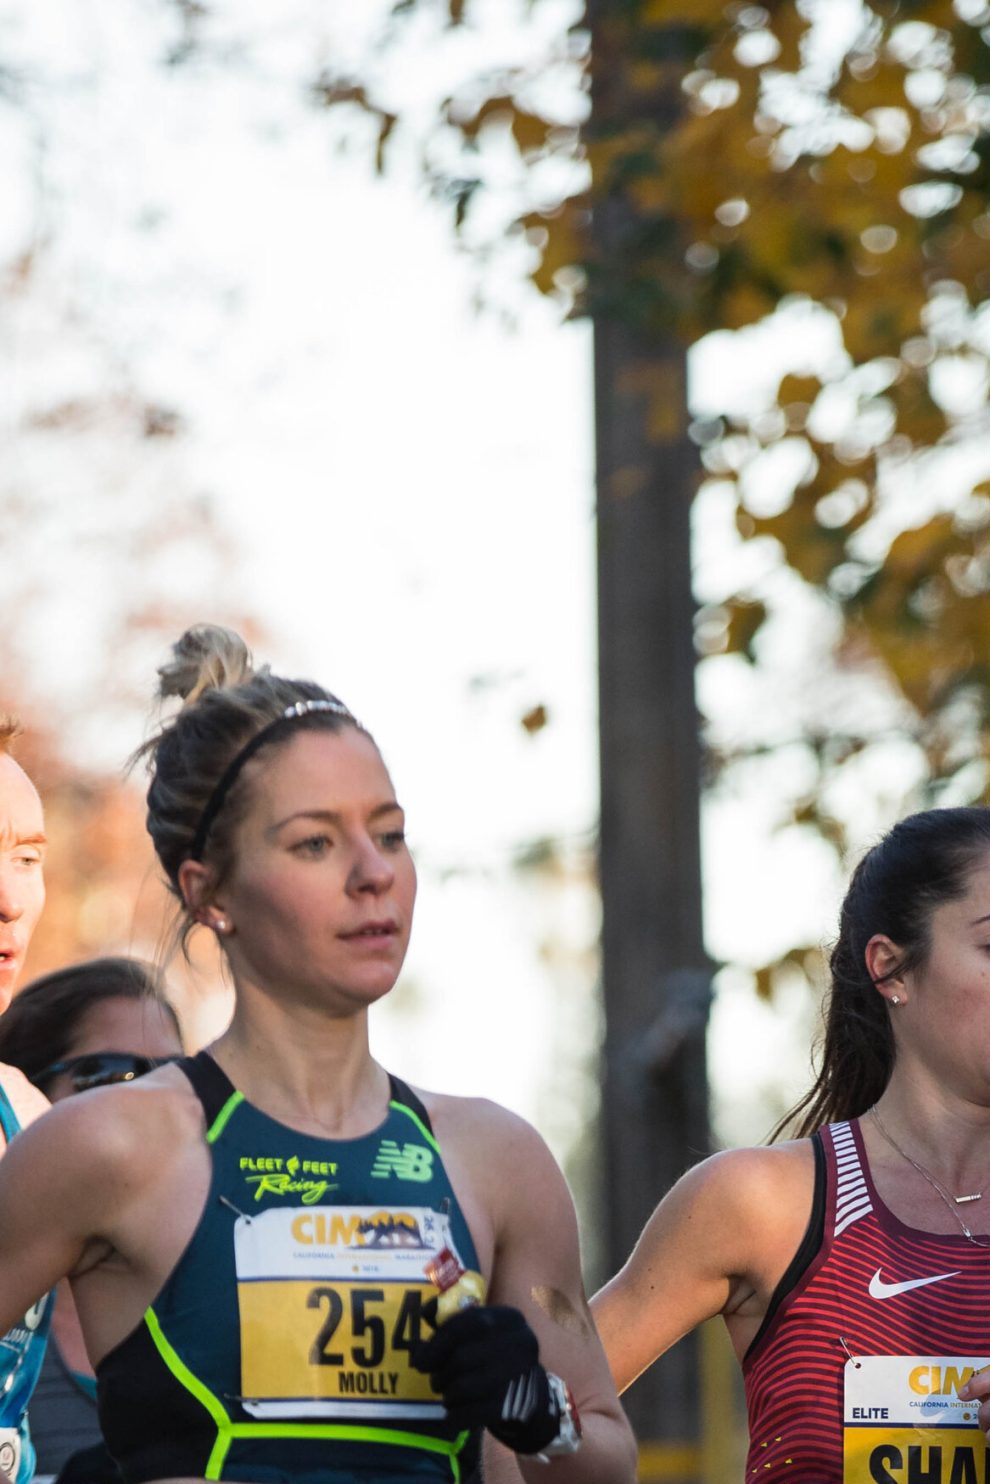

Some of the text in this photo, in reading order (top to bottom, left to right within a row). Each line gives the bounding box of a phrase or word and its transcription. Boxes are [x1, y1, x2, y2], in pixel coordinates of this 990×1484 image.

[239, 1157, 338, 1176] FLEET FEET
[244, 1173, 339, 1205] Racing
[290, 1212, 366, 1247] CIM
[306, 1286, 424, 1370] 254
[338, 1371, 399, 1395] MOLLY
[852, 1407, 889, 1419] ELITE
[909, 1401, 949, 1409] CALIFORNIA
